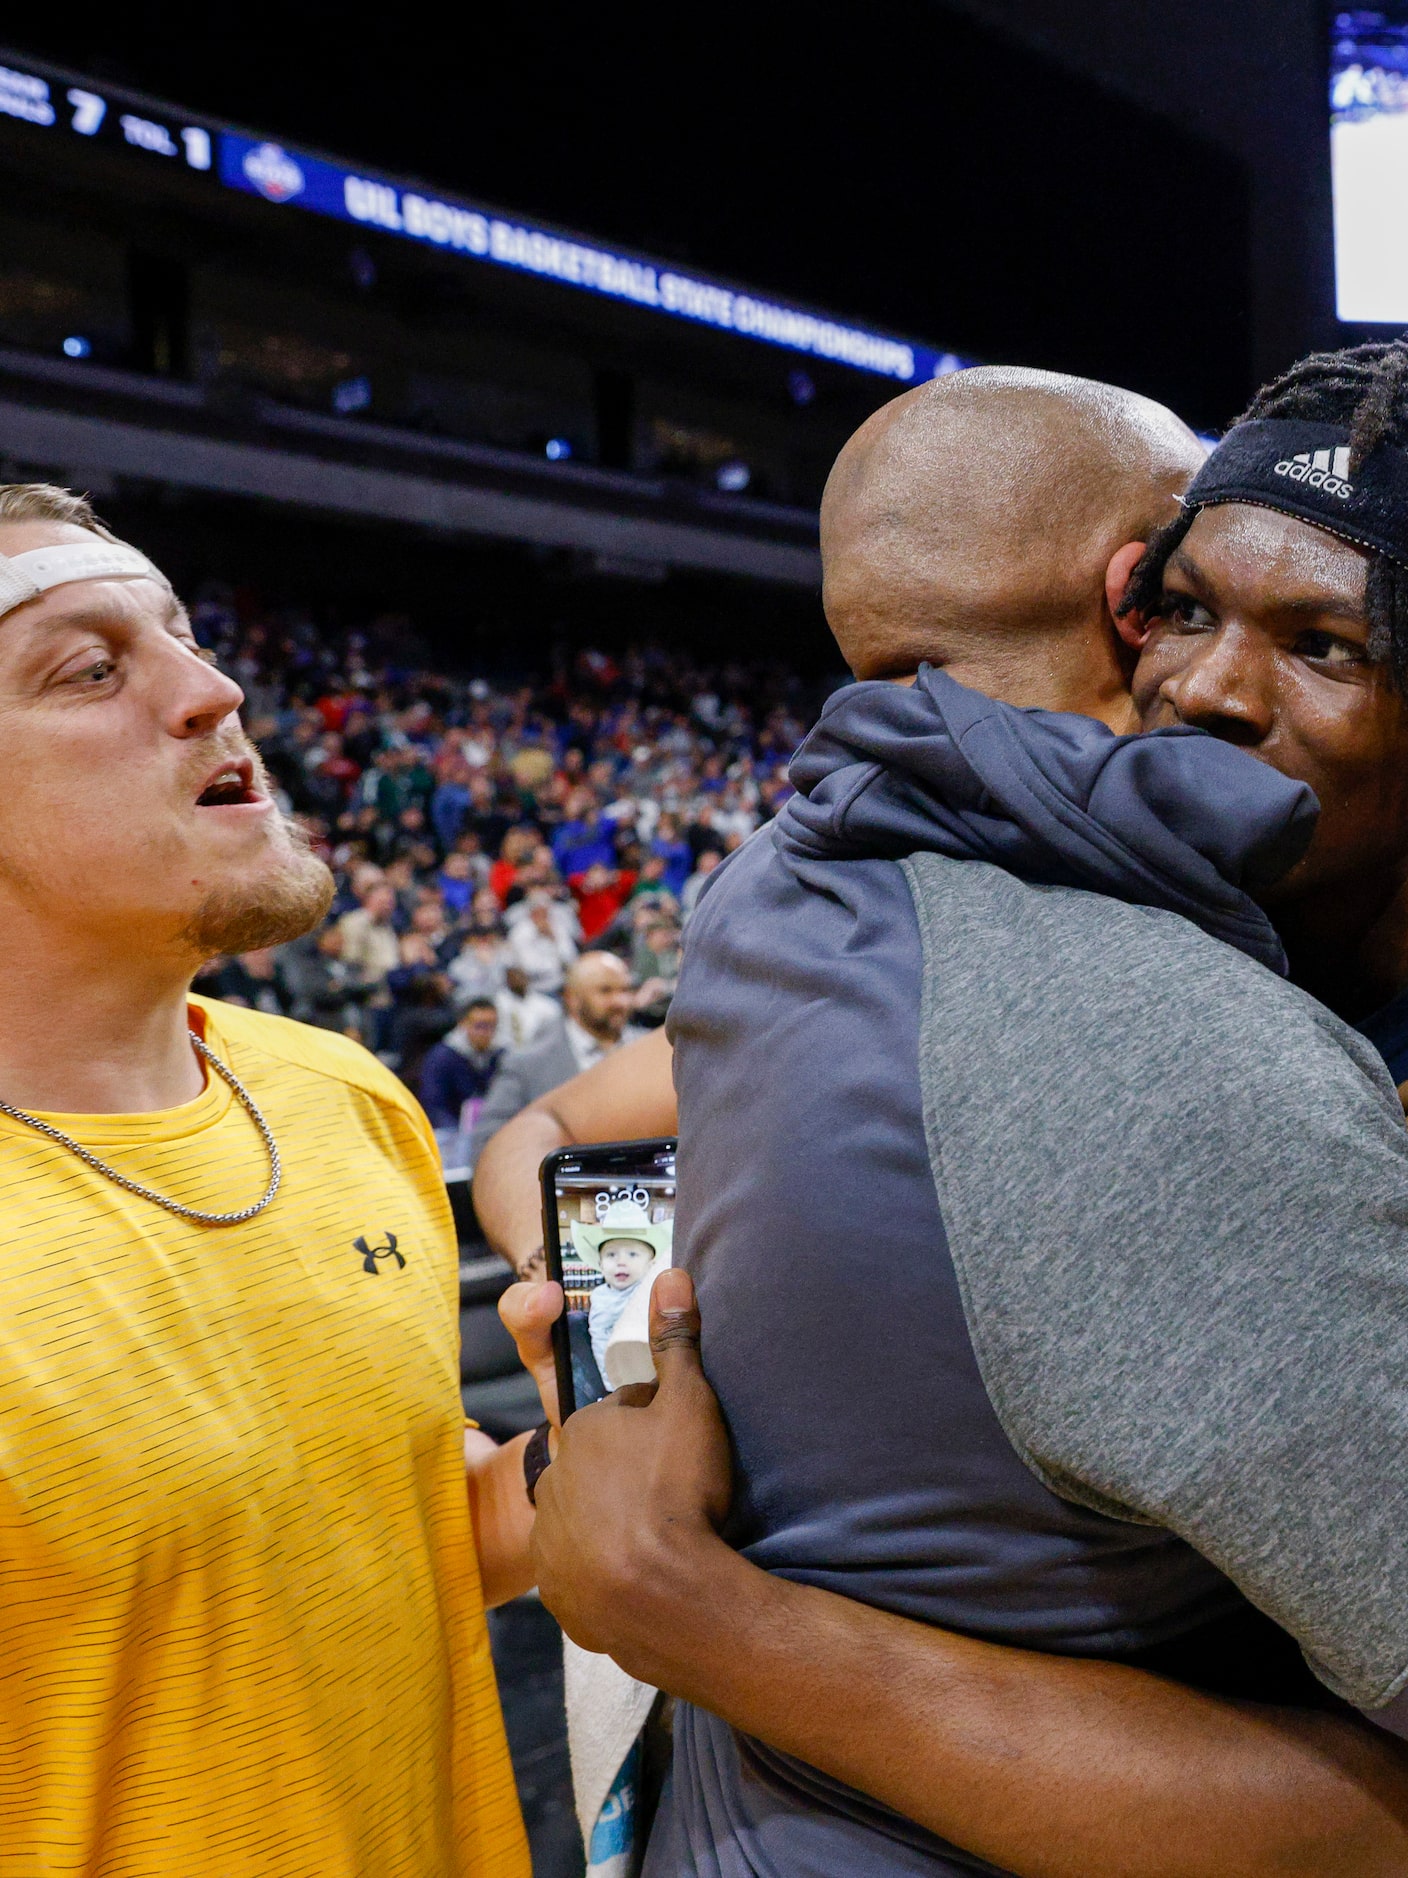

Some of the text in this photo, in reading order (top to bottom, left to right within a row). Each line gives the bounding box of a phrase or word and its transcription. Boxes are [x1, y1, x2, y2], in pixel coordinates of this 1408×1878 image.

[68, 89, 106, 135] 7
[181, 127, 211, 170] 1
[344, 176, 915, 379] UIL BOYS BASKETBALL STATE CHAMPIONSHIPS
[1273, 459, 1354, 499] adidas
